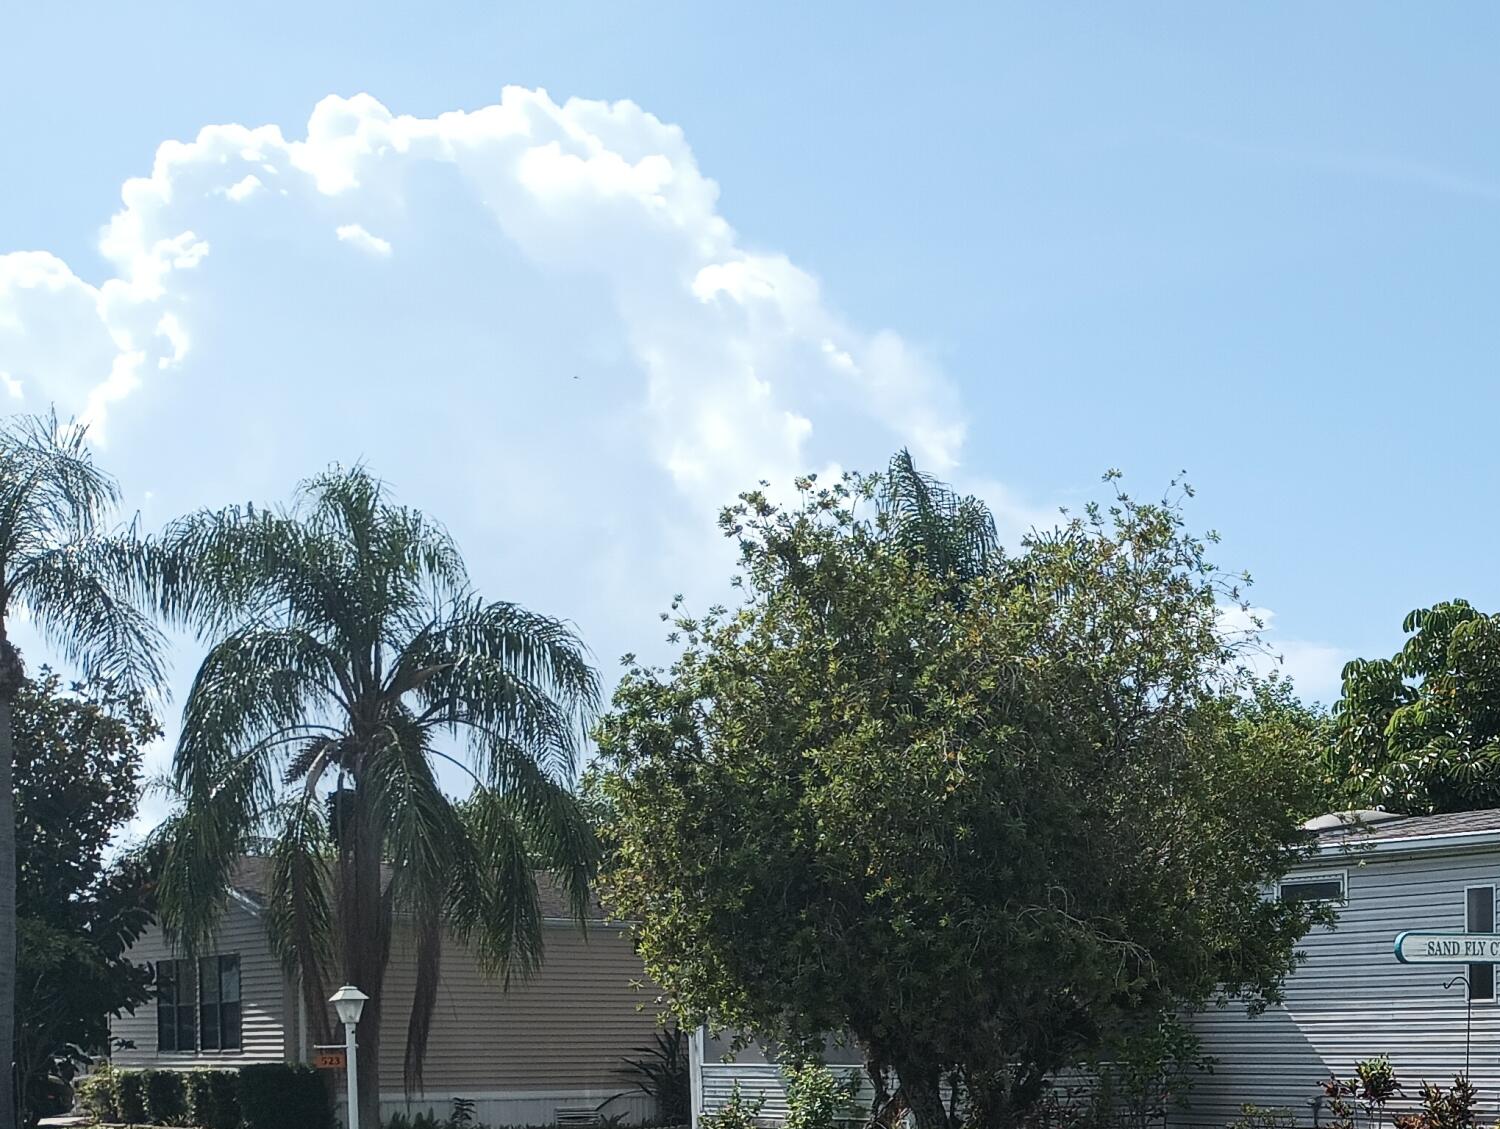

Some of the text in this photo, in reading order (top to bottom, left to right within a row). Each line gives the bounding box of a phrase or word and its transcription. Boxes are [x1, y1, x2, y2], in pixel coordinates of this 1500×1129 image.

[1427, 941, 1460, 956] SAND
[1464, 941, 1486, 956] FLY
[321, 1056, 341, 1065] 523
